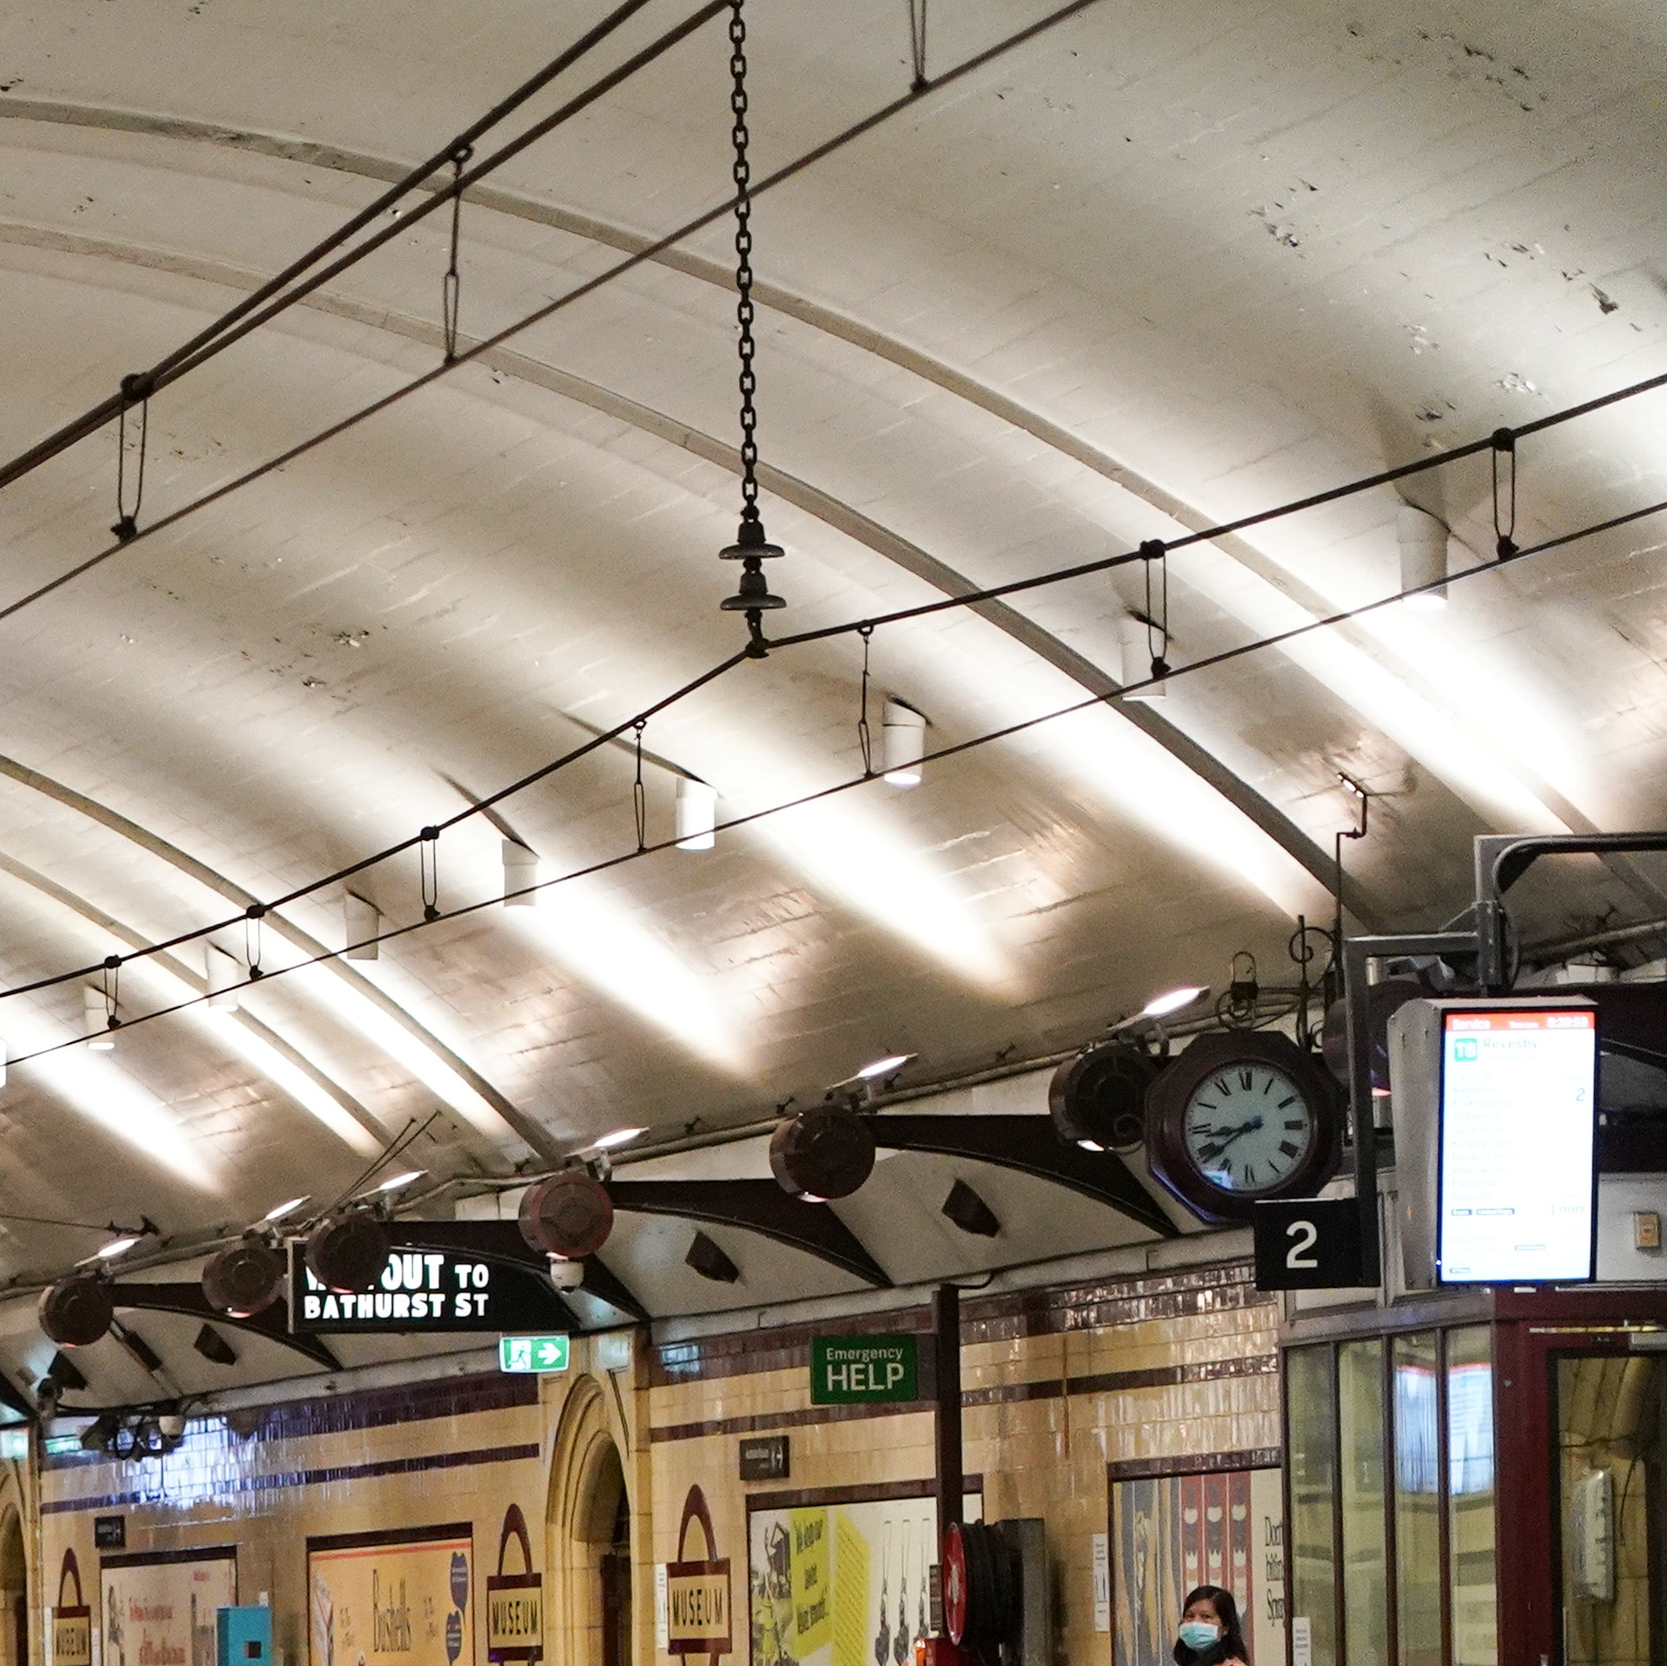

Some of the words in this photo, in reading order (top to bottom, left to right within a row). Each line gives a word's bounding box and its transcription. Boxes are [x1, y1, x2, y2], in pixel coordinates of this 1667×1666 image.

[1285, 1220, 1318, 1269] 2
[454, 1263, 489, 1289] TO
[303, 1292, 446, 1319] BATHURST
[454, 1292, 489, 1318] ST
[826, 1347, 904, 1362] Emergency
[827, 1362, 905, 1391] HELP
[492, 1599, 538, 1636] MUSEUM
[672, 1586, 723, 1627] MUSEUM
